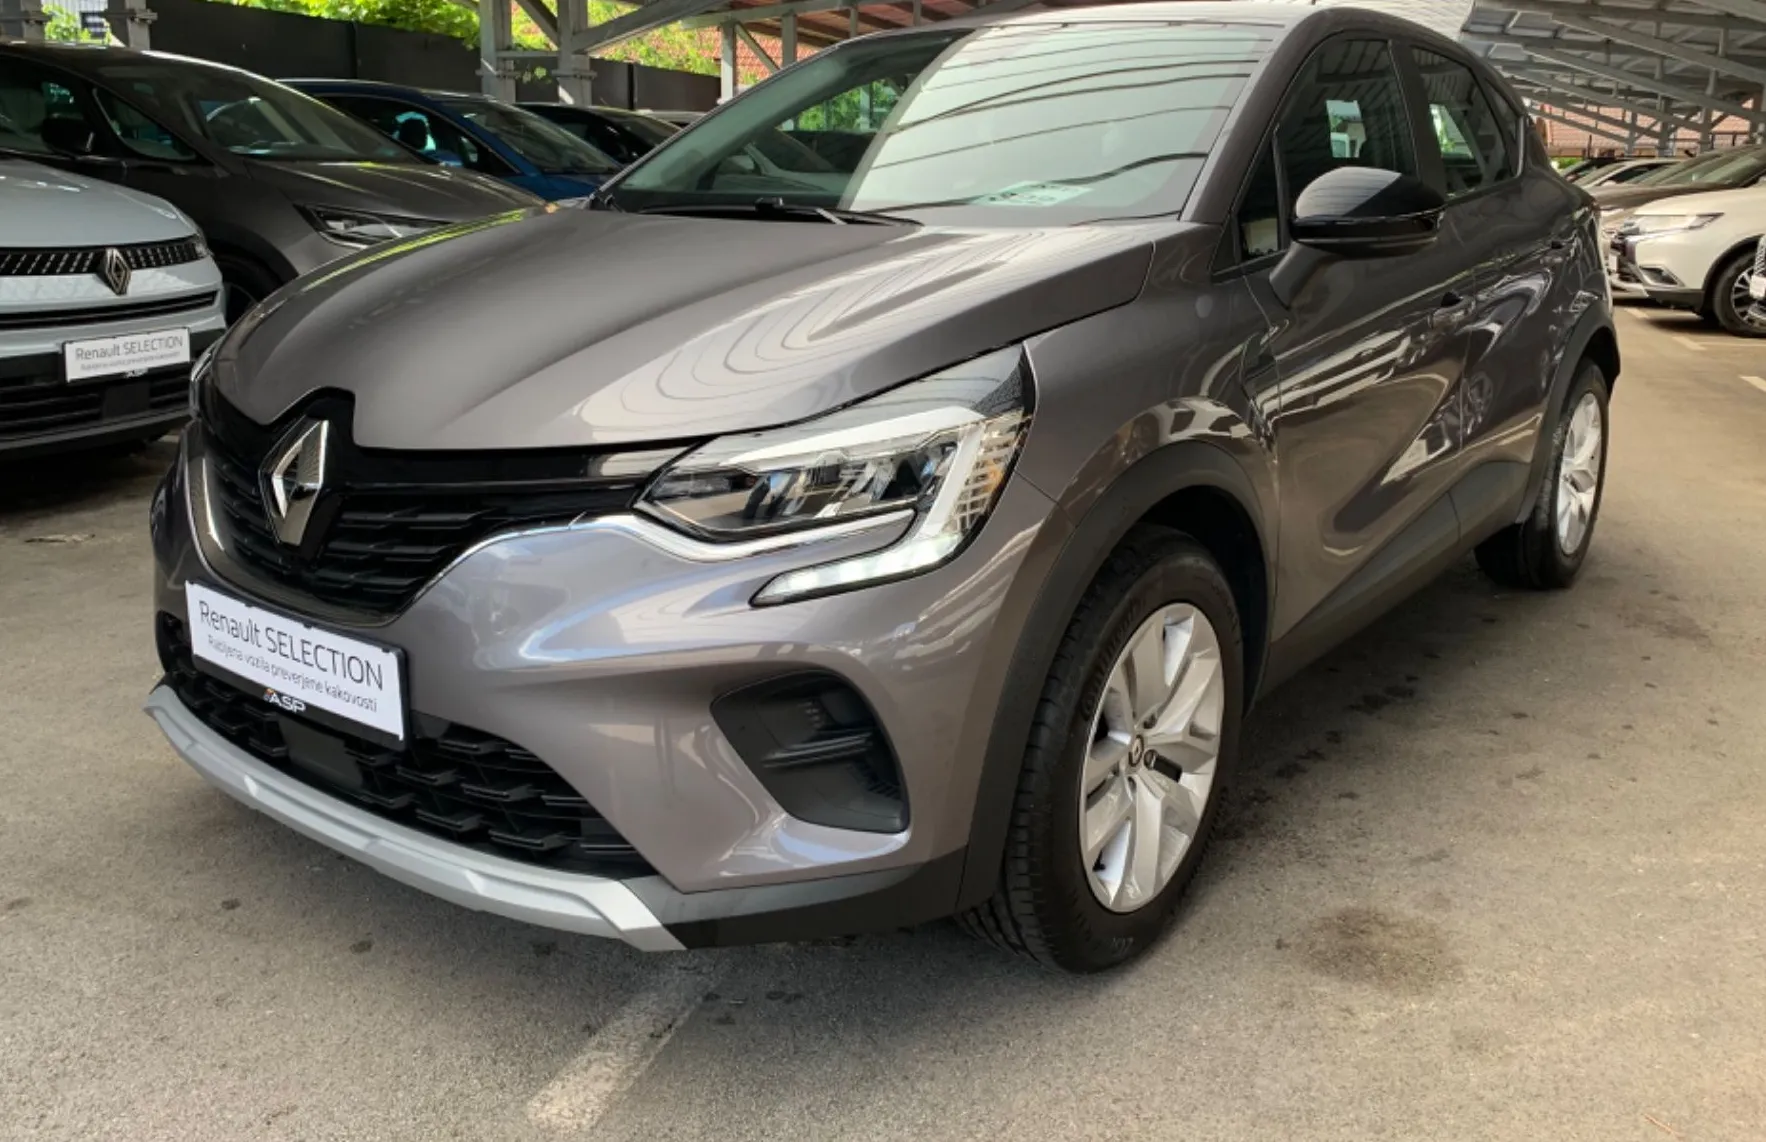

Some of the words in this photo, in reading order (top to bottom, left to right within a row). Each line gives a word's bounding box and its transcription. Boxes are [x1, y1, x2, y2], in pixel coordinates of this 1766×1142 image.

[75, 344, 120, 361] Renault
[122, 335, 183, 355] SELECTION
[198, 600, 262, 648] Renault
[265, 627, 384, 691] SELECTION
[268, 691, 307, 713] ASP
[271, 663, 323, 693] preverjene
[325, 680, 378, 713] kakovosti
